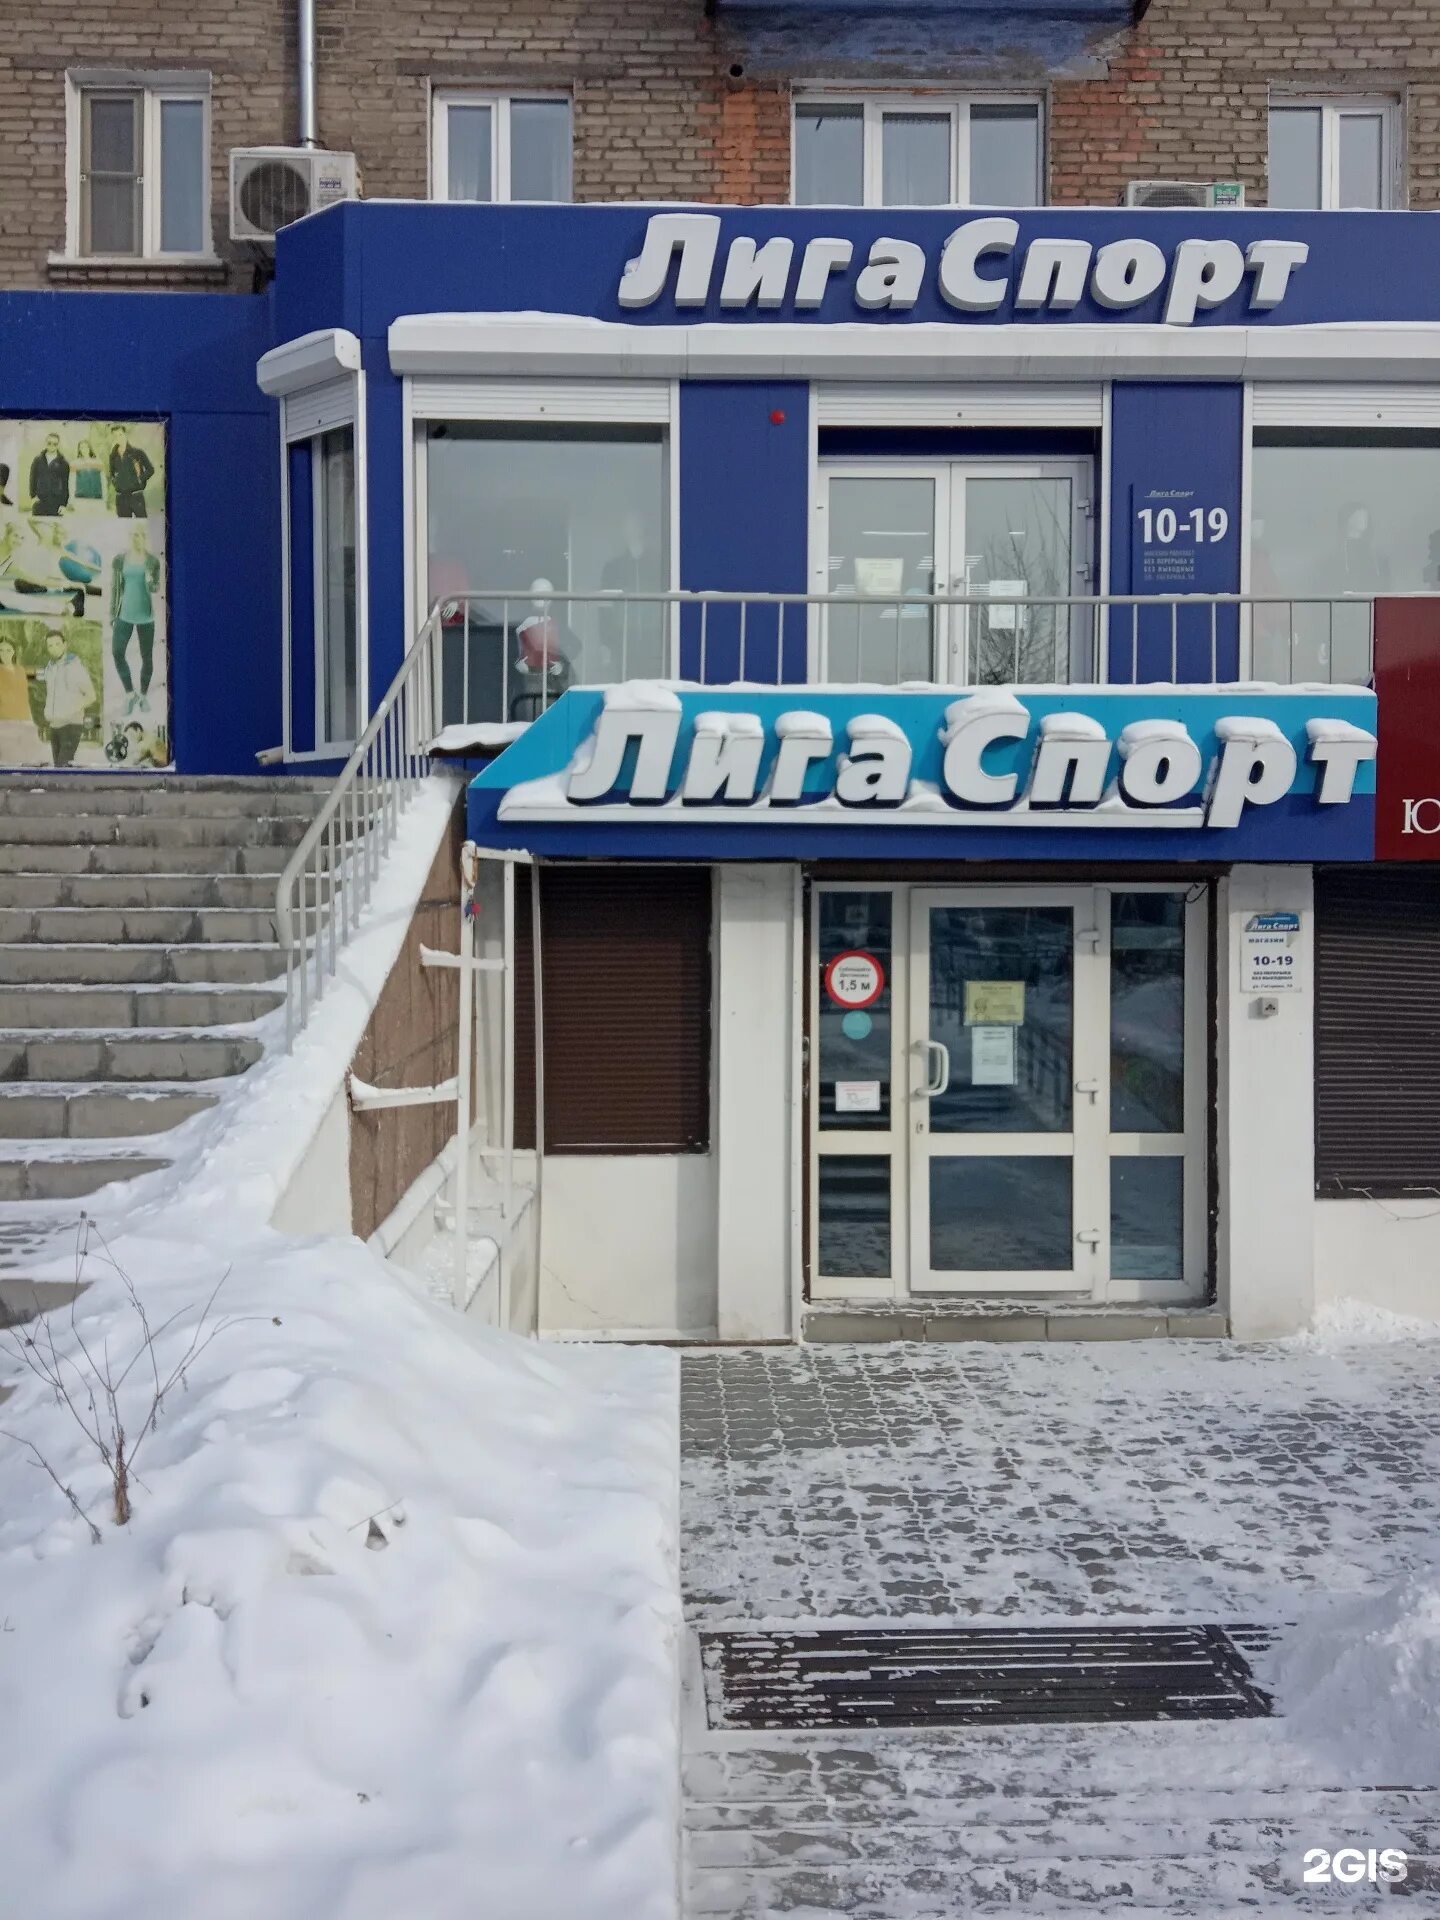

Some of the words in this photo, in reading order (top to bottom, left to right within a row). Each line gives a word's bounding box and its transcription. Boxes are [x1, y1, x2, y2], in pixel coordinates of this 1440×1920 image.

[1137, 507, 1229, 543] 10-19
[1253, 955, 1293, 966] 10-19
[839, 979, 857, 992] 1,5
